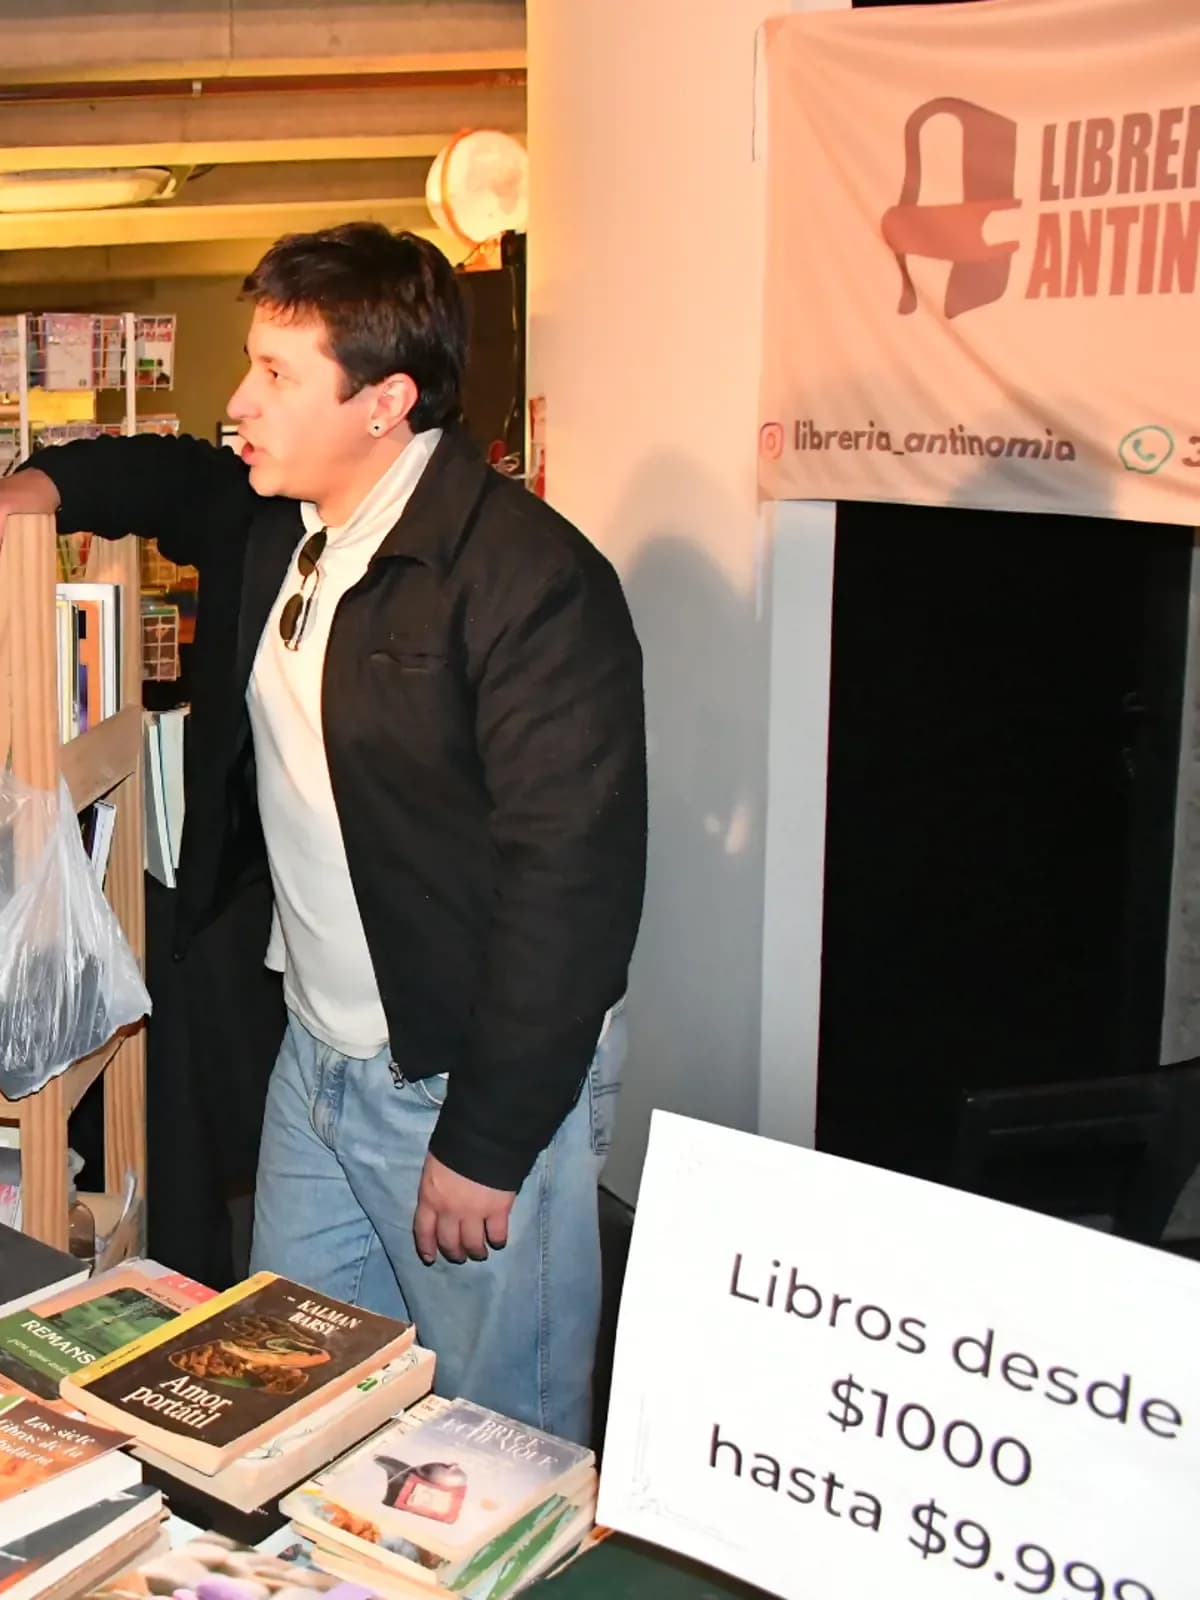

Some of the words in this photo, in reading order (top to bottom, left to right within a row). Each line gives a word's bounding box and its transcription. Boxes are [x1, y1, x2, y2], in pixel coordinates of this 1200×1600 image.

[1024, 200, 1200, 299] ANTIN
[794, 420, 1076, 462] libreria_antinomia
[296, 1299, 363, 1329] KALMAN
[728, 1252, 928, 1356] Libros
[951, 1328, 1184, 1440] desde
[120, 1386, 224, 1431] portátil
[158, 1375, 233, 1413] Amor
[826, 1373, 1033, 1487] $1000
[708, 1423, 883, 1533] hasta
